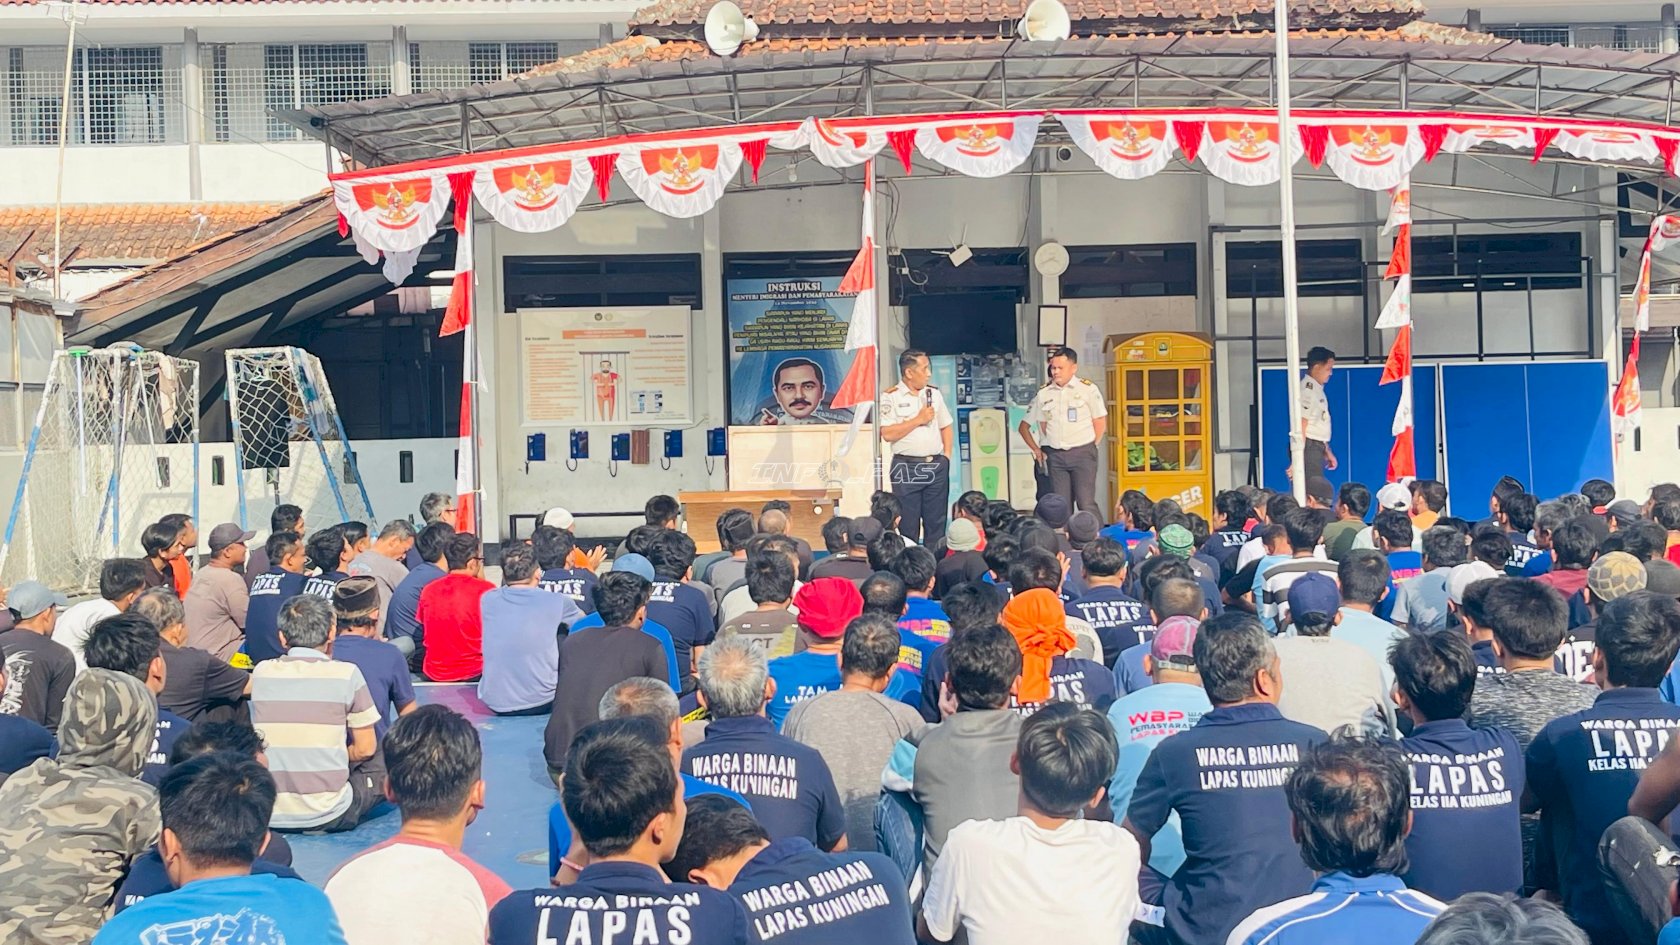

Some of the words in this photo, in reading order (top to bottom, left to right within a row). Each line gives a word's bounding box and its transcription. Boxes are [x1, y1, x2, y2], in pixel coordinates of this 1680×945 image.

[768, 281, 821, 292] INSTRUKSI
[543, 582, 582, 594] APAS
[1083, 606, 1141, 622] LAPAS
[1128, 711, 1184, 726] WBP
[1580, 719, 1636, 730] WARGA
[1640, 718, 1680, 729] BINA
[1195, 746, 1247, 767] WARGA
[1247, 743, 1299, 765] BINAAN
[1588, 758, 1627, 772] KELAS
[1629, 757, 1648, 770] IIA
[692, 752, 741, 777] WARGA
[743, 753, 796, 778] BINAAN
[1200, 770, 1239, 790] LAPAS
[1240, 767, 1291, 789] KUNING
[1408, 760, 1506, 795] LAPAS
[1409, 795, 1439, 808] ELAS
[1440, 795, 1459, 808] IIA
[1459, 789, 1513, 808] KUNINGAN
[742, 880, 811, 913] WARGA
[807, 860, 873, 898] BINAAN
[534, 894, 609, 910] WARGA
[615, 892, 701, 908] BINAAN
[754, 910, 809, 941] LAPAS
[807, 883, 890, 926] KUNINGAN
[536, 905, 693, 945] LAPAS
